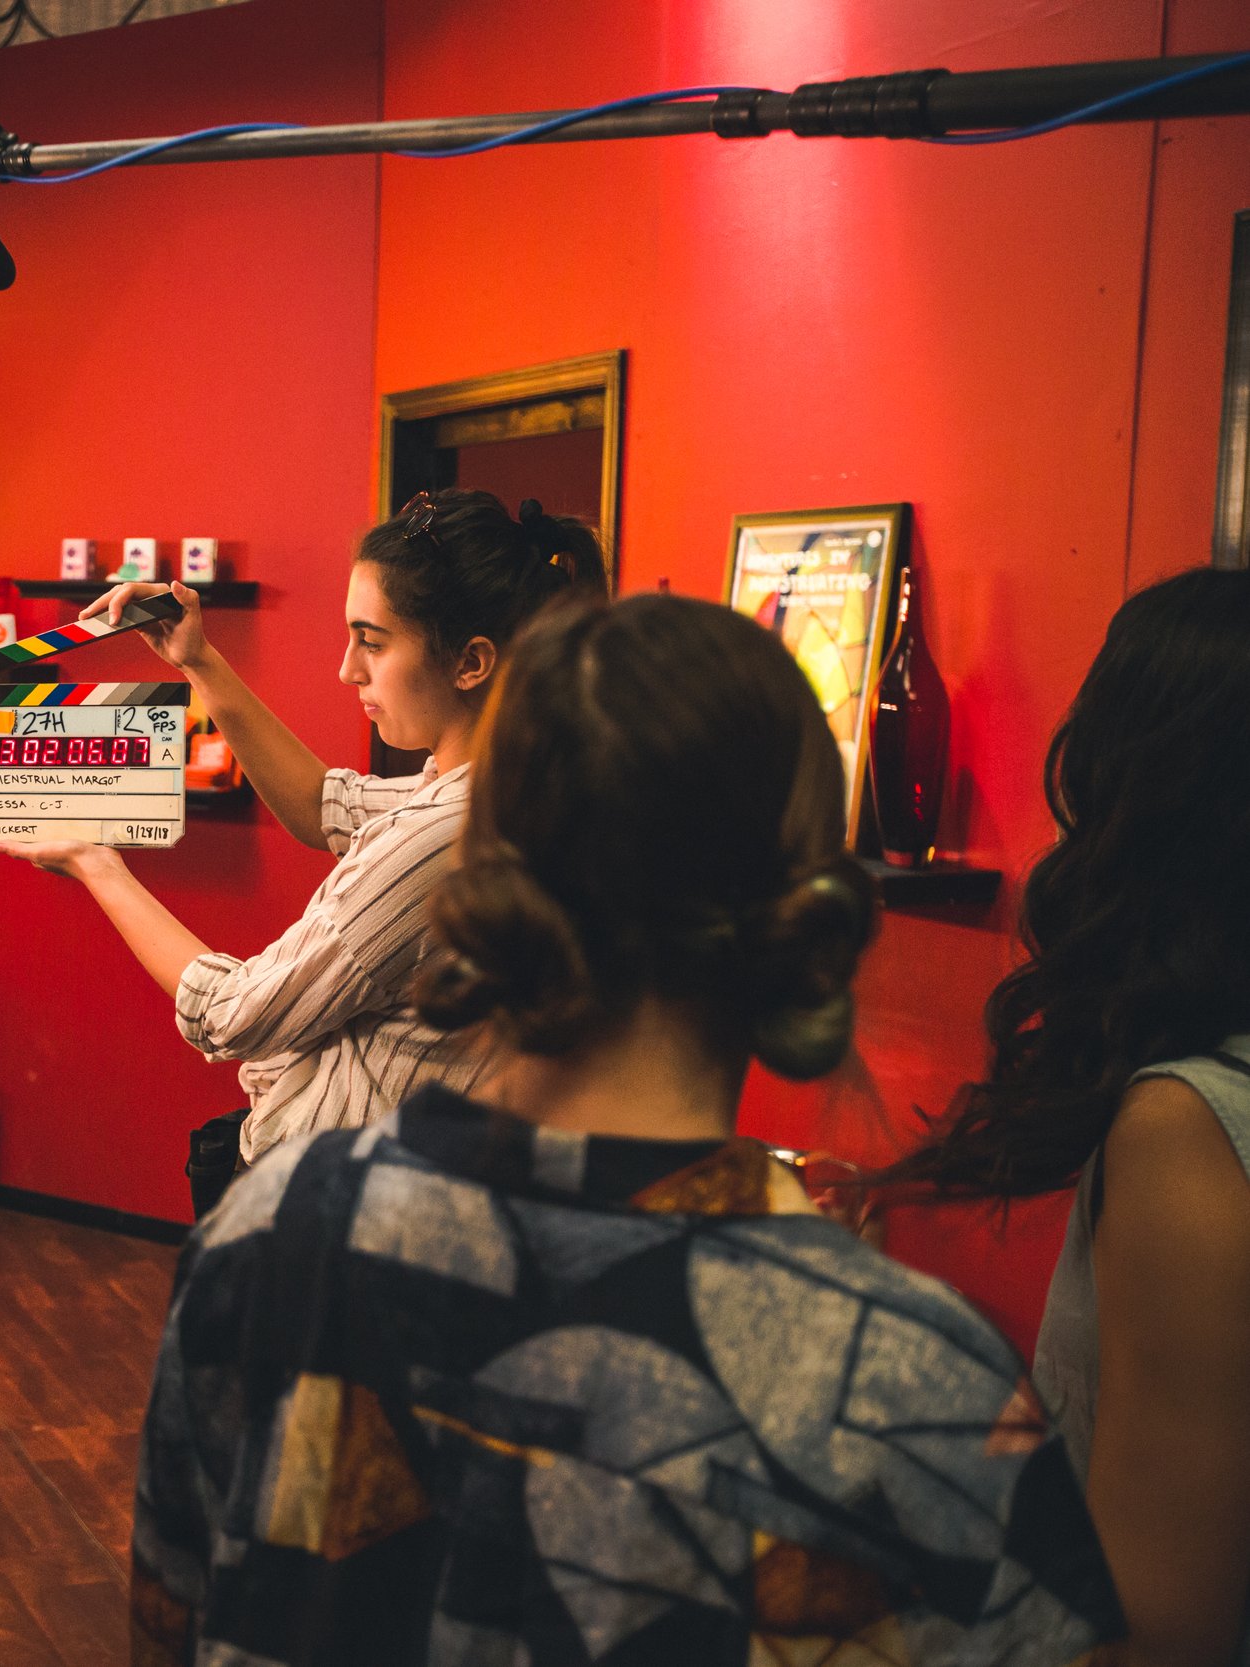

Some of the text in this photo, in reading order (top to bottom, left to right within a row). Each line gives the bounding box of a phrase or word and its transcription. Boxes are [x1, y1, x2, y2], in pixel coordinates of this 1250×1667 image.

[122, 706, 144, 734] 2
[147, 706, 169, 721] 60
[22, 711, 66, 736] 27H
[153, 720, 176, 734] FPS
[161, 748, 175, 761] A
[71, 775, 122, 787] MARGOT
[126, 824, 170, 841] 9/28/18
